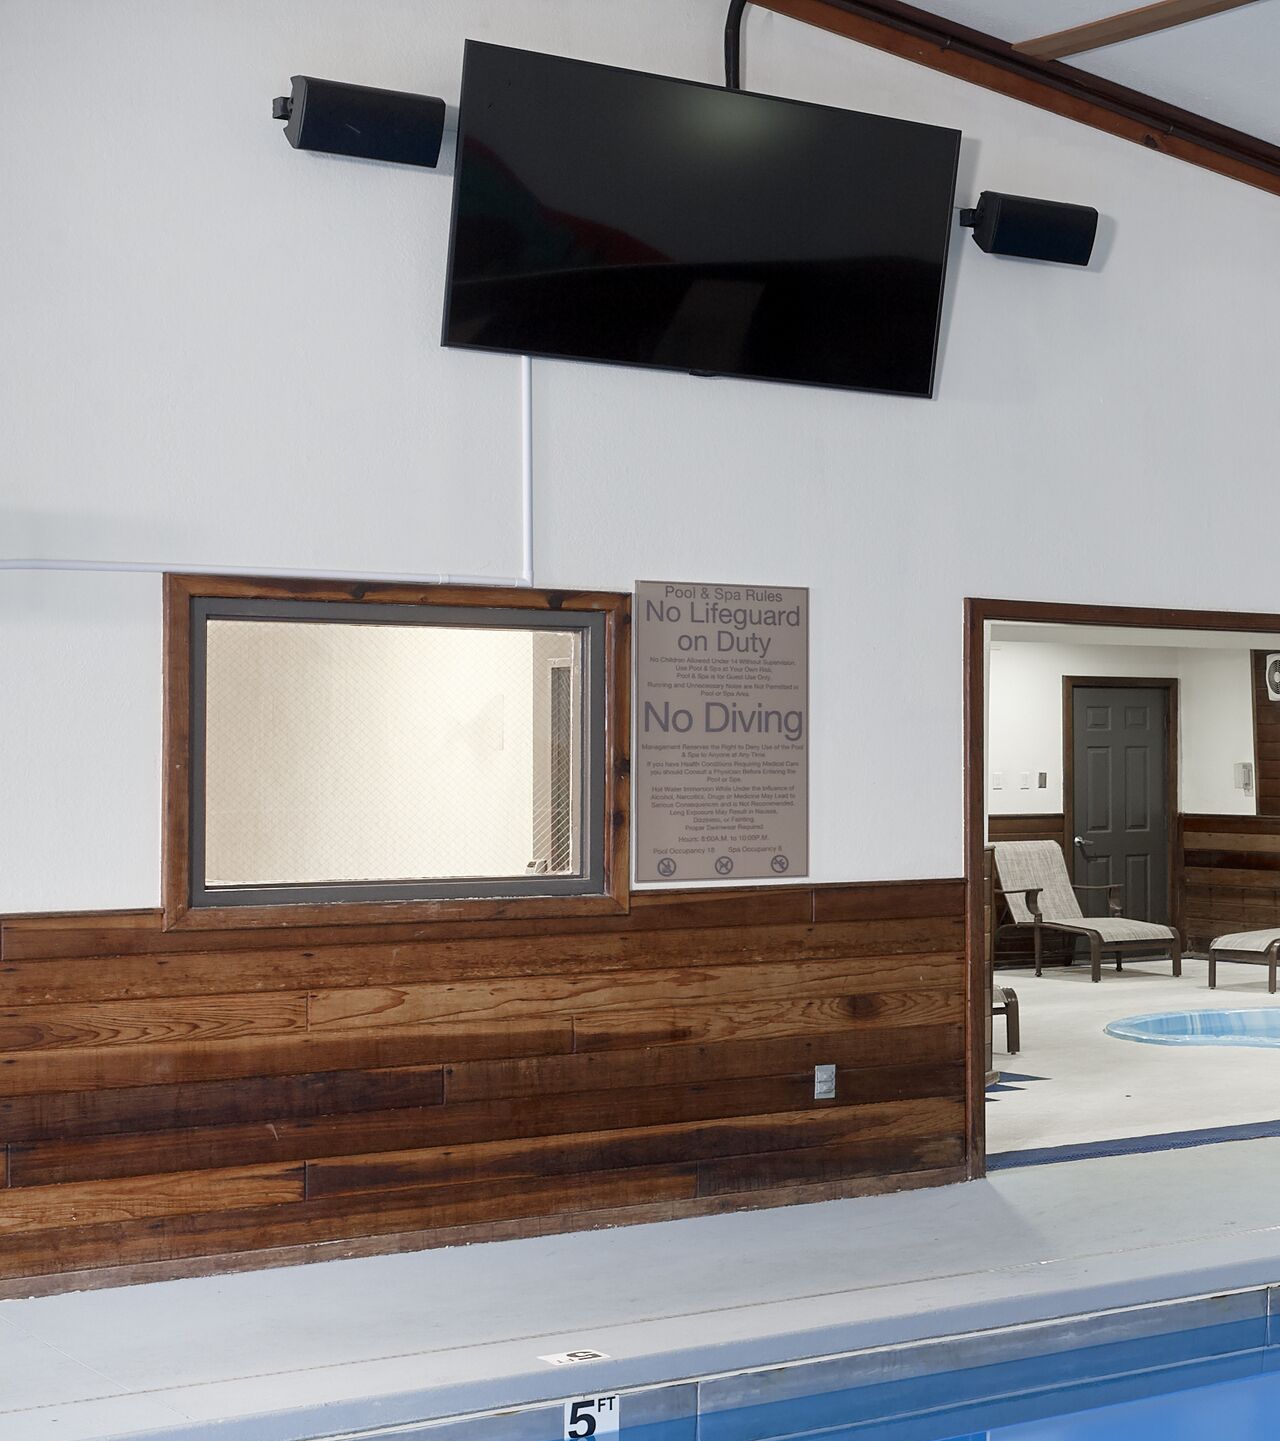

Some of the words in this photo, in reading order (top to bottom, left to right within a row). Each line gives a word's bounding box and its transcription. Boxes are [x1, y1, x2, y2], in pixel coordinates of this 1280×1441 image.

[665, 585, 696, 598] Pool
[700, 587, 710, 600] &
[714, 588, 741, 602] Spa
[745, 589, 783, 603] Rules
[646, 600, 681, 623] No
[691, 601, 800, 630] Lifeguard
[677, 634, 708, 651] on
[717, 630, 772, 658] Duty
[644, 701, 693, 733] No
[705, 702, 803, 741] Diving
[568, 1400, 596, 1438] 5
[598, 1396, 616, 1412] FT
